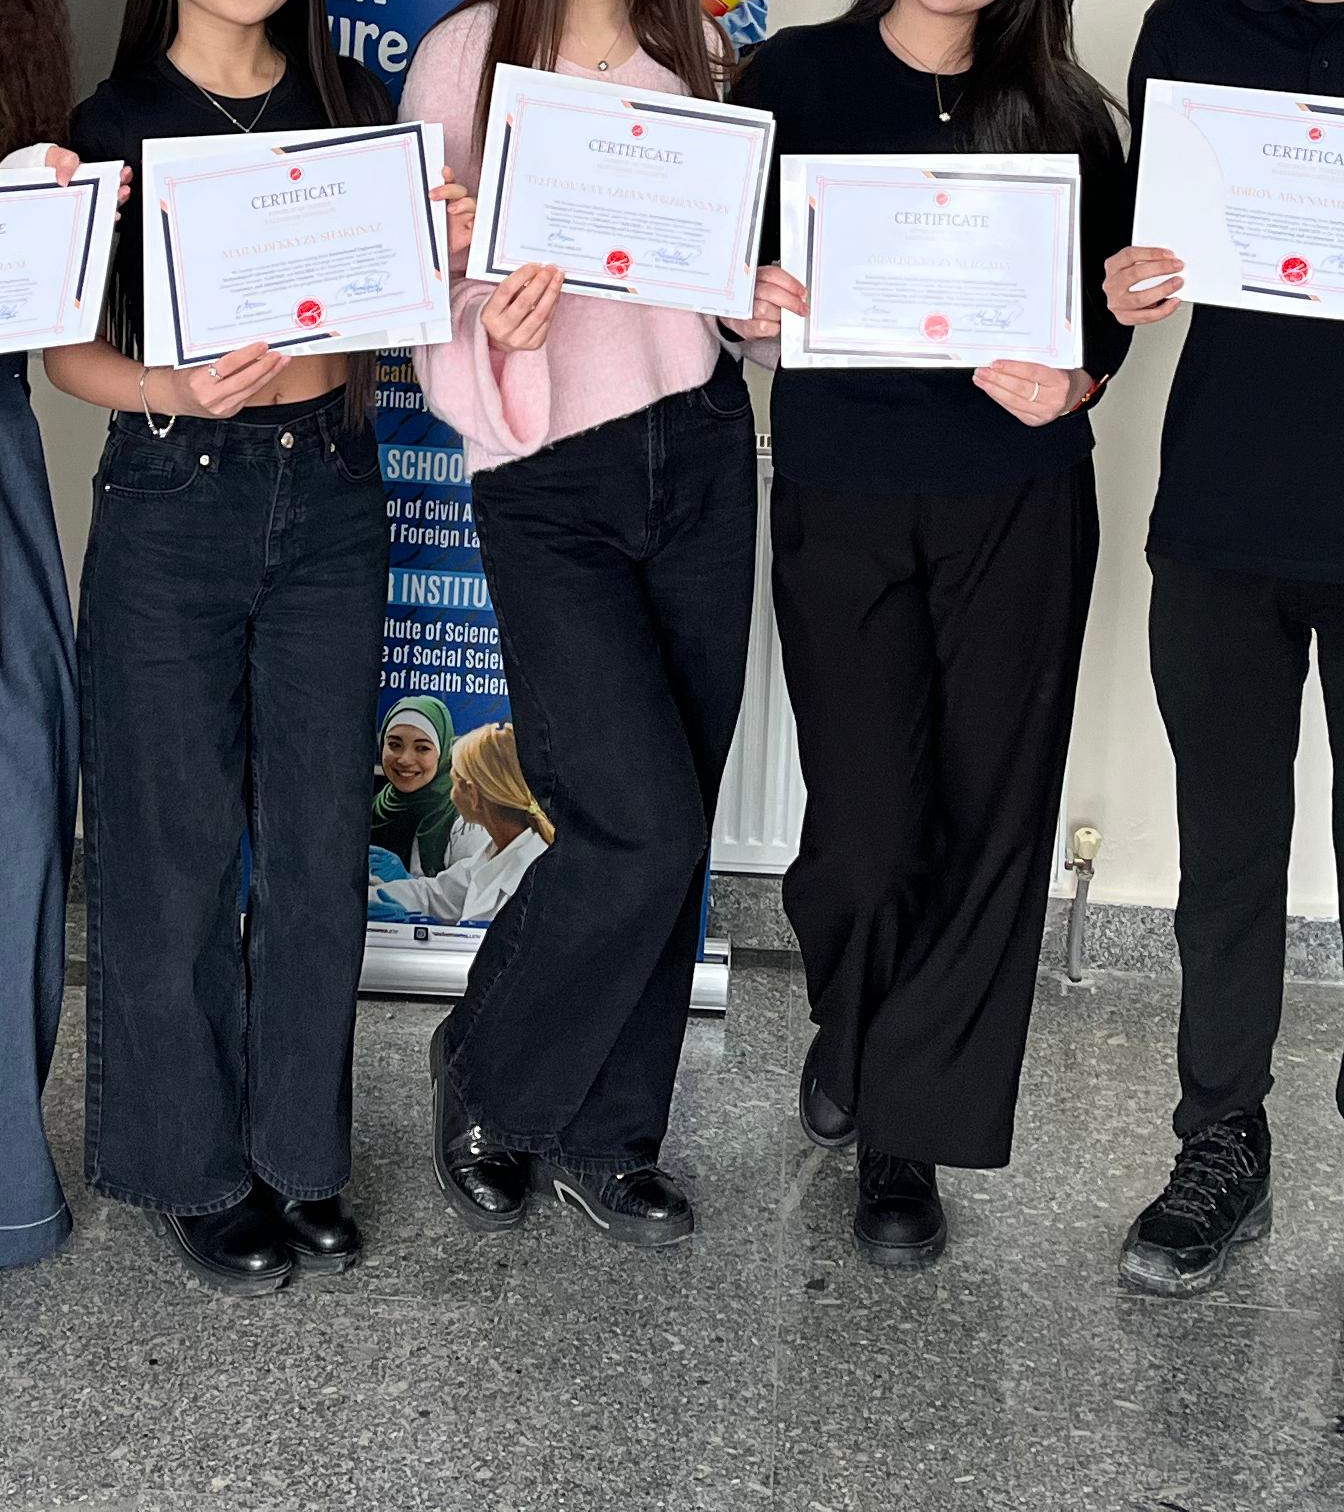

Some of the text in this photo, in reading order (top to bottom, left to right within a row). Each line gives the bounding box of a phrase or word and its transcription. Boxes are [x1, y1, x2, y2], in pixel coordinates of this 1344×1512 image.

[589, 138, 684, 165] CERTIFICATE
[251, 182, 347, 210] CERTIFICATE
[894, 211, 990, 228] CERTIFICATE
[386, 449, 465, 483] SCHOO
[386, 498, 401, 518] ol
[405, 499, 422, 519] of
[425, 499, 459, 522] Civil
[400, 524, 460, 548] Foreign
[464, 528, 481, 548] La
[401, 573, 490, 608] INSTITU
[383, 616, 498, 645] itute of Scienc
[393, 645, 410, 664] of
[413, 645, 462, 668] Social
[390, 669, 407, 689] of
[410, 670, 462, 693] Health
